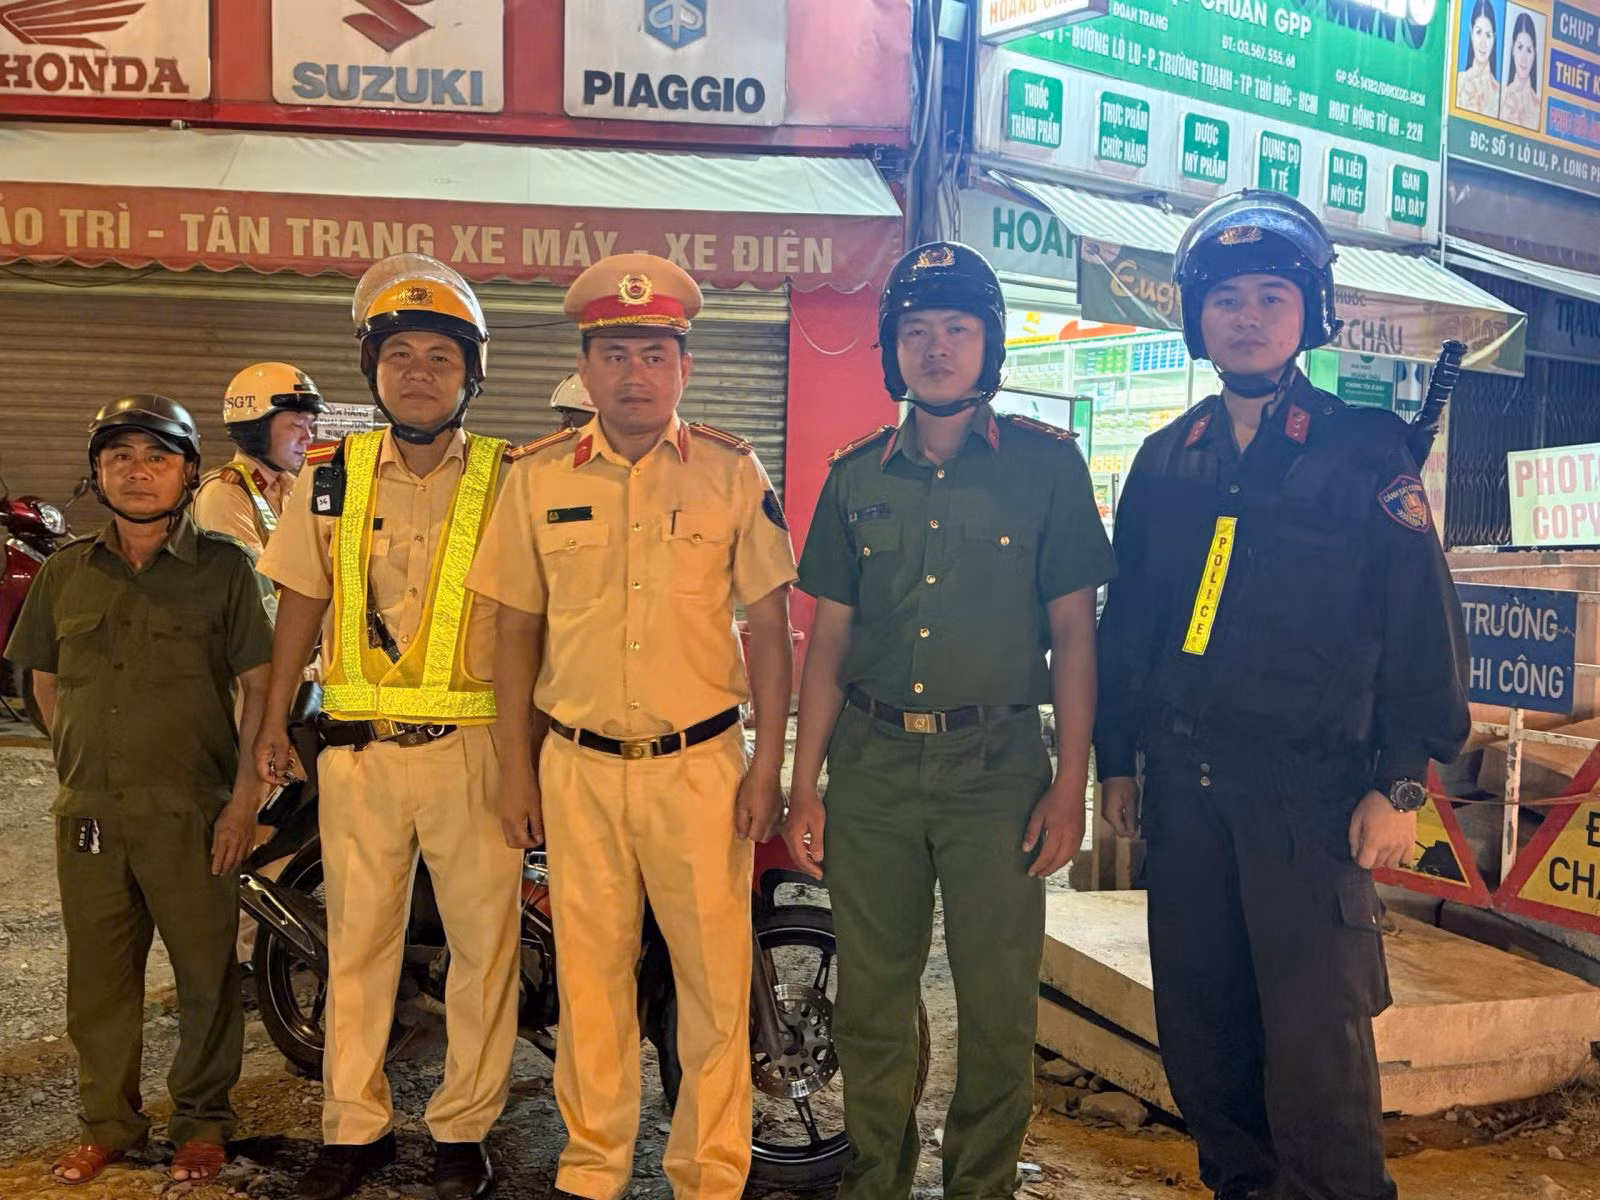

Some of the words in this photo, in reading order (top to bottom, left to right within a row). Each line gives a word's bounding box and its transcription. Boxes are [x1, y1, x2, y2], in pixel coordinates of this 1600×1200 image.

[1274, 7, 1312, 39] GPP
[1560, 13, 1594, 45] CHỤP
[0, 53, 189, 93] HONDA
[292, 62, 484, 106] SUZUKI
[583, 70, 765, 114] PIAGGIO
[1556, 61, 1590, 91] THIẾT
[1406, 121, 1423, 142] 22H
[1470, 130, 1489, 152] ĐC:
[1492, 134, 1507, 157] SỐ
[1509, 142, 1515, 159] 1
[1551, 154, 1561, 172] P.
[1563, 157, 1588, 179] LONG
[1402, 171, 1420, 192] GAN
[59, 202, 131, 249] TRÌ
[180, 207, 271, 255] TÂN
[286, 218, 434, 260] TRANG
[450, 225, 506, 264] XE
[522, 222, 620, 267] MÁY
[665, 233, 718, 271] XE
[224, 395, 256, 409] SGT
[1514, 454, 1600, 498] PHOT
[1532, 502, 1600, 541] COPY
[1196, 536, 1227, 635] POLICE
[1462, 596, 1558, 641] TRƯỜNG
[1469, 655, 1492, 690] HI
[1498, 654, 1564, 699] CÔNG
[1549, 856, 1600, 900] CH
